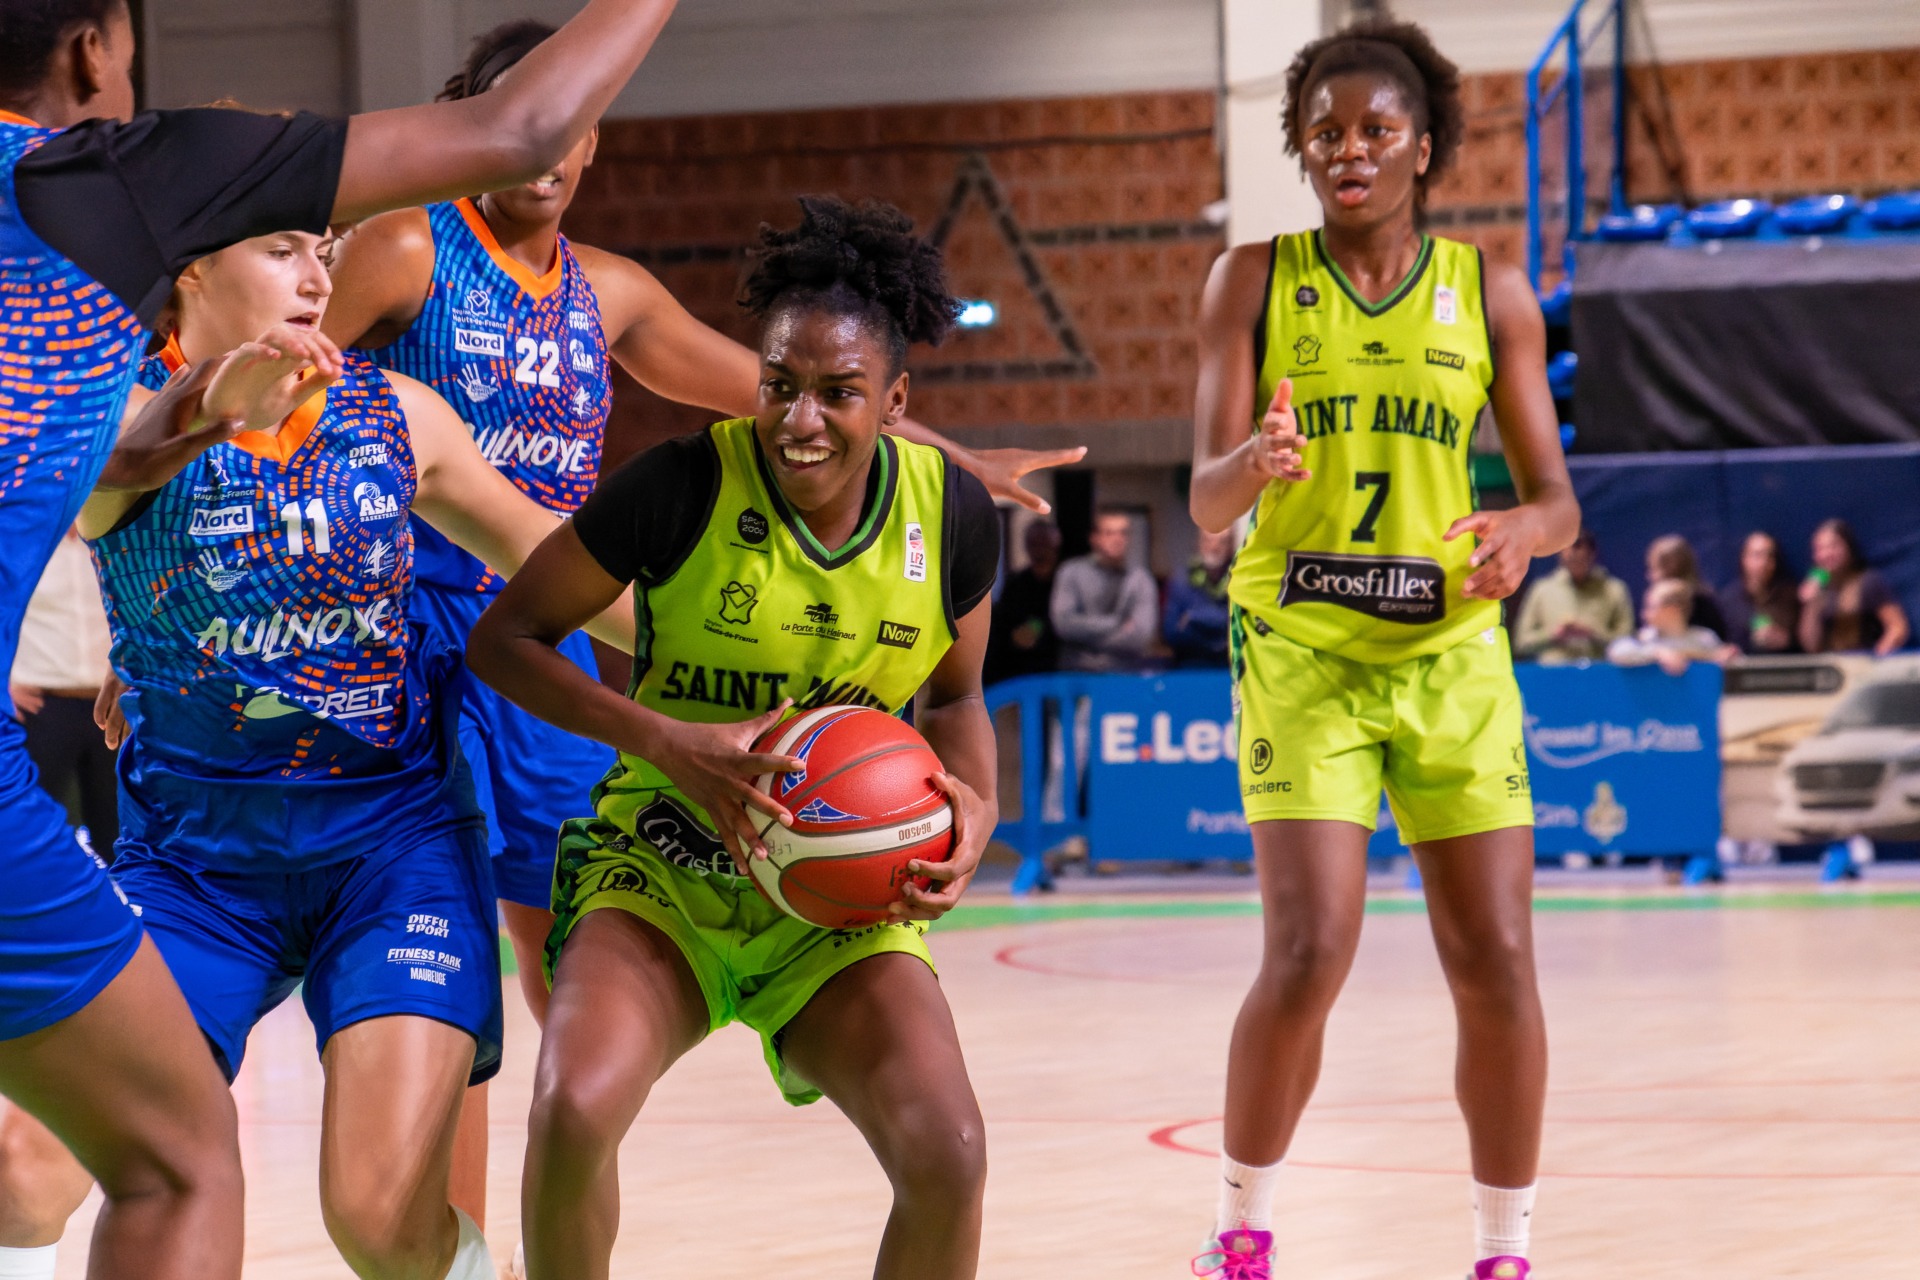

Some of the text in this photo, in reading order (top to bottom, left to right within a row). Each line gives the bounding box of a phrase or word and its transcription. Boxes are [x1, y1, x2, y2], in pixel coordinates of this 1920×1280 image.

[459, 332, 501, 350] Nord
[515, 336, 560, 388] 22
[1428, 350, 1463, 367] Nord
[1294, 395, 1358, 440] INT
[349, 443, 386, 458] DIFFU
[465, 421, 591, 477] ULNOYE
[349, 453, 388, 469] SPORT
[360, 494, 398, 516] ASA
[1351, 472, 1390, 543] 7
[194, 507, 248, 528] Nord
[360, 511, 399, 522] BASKETBALL
[281, 498, 330, 555] 11
[741, 524, 765, 536] 2000
[910, 551, 924, 566] LF2
[1296, 564, 1435, 599] Grosfillex
[781, 622, 790, 631] La
[792, 623, 814, 632] Porte
[882, 624, 918, 643] Nord
[660, 661, 788, 711] SAINT
[898, 822, 932, 841] BG4500
[406, 924, 449, 938] SPORT
[408, 914, 449, 929] DIFFU
[387, 948, 435, 960] FITNESS
[438, 952, 461, 969] PARK
[410, 967, 446, 986] MAUBEUGE
